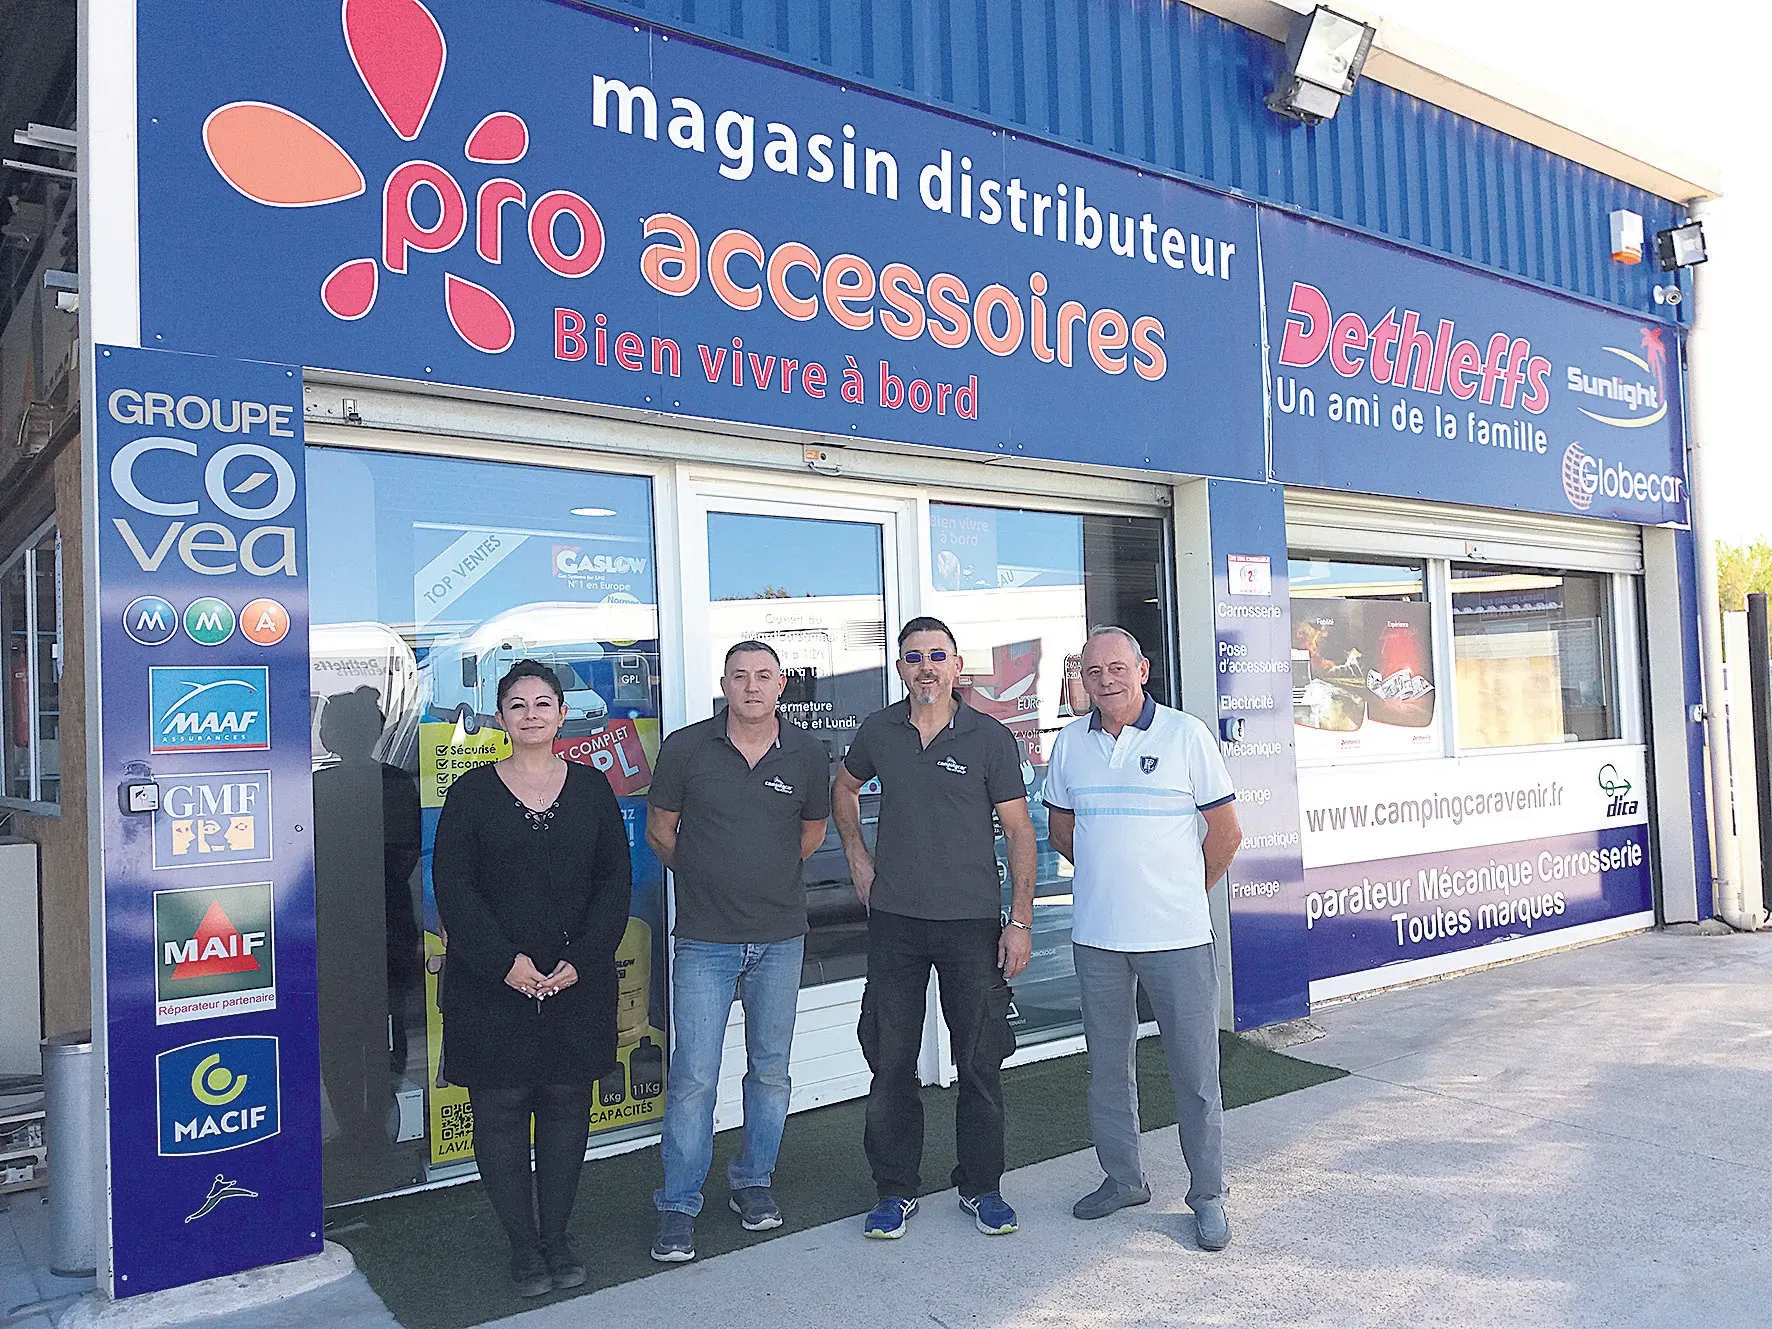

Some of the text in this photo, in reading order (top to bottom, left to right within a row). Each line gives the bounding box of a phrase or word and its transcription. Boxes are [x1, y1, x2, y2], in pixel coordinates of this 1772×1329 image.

[593, 75, 1235, 280] magasin distributeur
[382, 160, 1168, 381] pro accessoires
[1279, 282, 1552, 415] Dethleffs
[554, 308, 978, 420] Bien vivre à bord
[1568, 366, 1660, 410] Sunlight
[108, 389, 294, 437] GROUPE
[1277, 376, 1548, 454] Un ami de la famille
[1579, 455, 1682, 503] Globecar
[930, 514, 988, 531] Bien vivre
[950, 532, 978, 546] bord
[424, 534, 502, 605] TOP VENTES
[556, 550, 647, 574] GASLOW
[600, 582, 631, 592] Europe
[1217, 602, 1281, 618] Carrosserie
[1219, 642, 1248, 657] Pose
[1219, 658, 1290, 673] d'accessoires
[621, 675, 640, 684] GPL
[775, 700, 833, 712] Fermeture
[1220, 695, 1274, 710] Electricité
[162, 712, 258, 734] MAAF
[811, 718, 823, 729] et
[826, 715, 856, 729] Lundi
[163, 734, 246, 743] ASSURANCES
[451, 744, 496, 755] Sécurisé
[569, 726, 629, 758] COMPLET
[1223, 741, 1281, 757] Mécanique
[588, 743, 640, 778] PL
[163, 783, 260, 818] GMF
[1235, 788, 1271, 805] idange
[1306, 782, 1564, 832] www.campingcaravenir.fr
[1606, 795, 1639, 818] dica
[1240, 831, 1300, 850] neumatique
[1232, 880, 1280, 899] Freinage
[1305, 840, 1642, 929] parateur Mécanique Carrosserie
[1392, 890, 1566, 946] Toutes marques
[164, 931, 266, 965] MAIF
[158, 992, 275, 1017] Réparateur partenaire
[603, 1082, 661, 1104] 6Kg 11Kg
[174, 1105, 267, 1143] MACIF
[589, 1101, 653, 1124] CAPACITÉS
